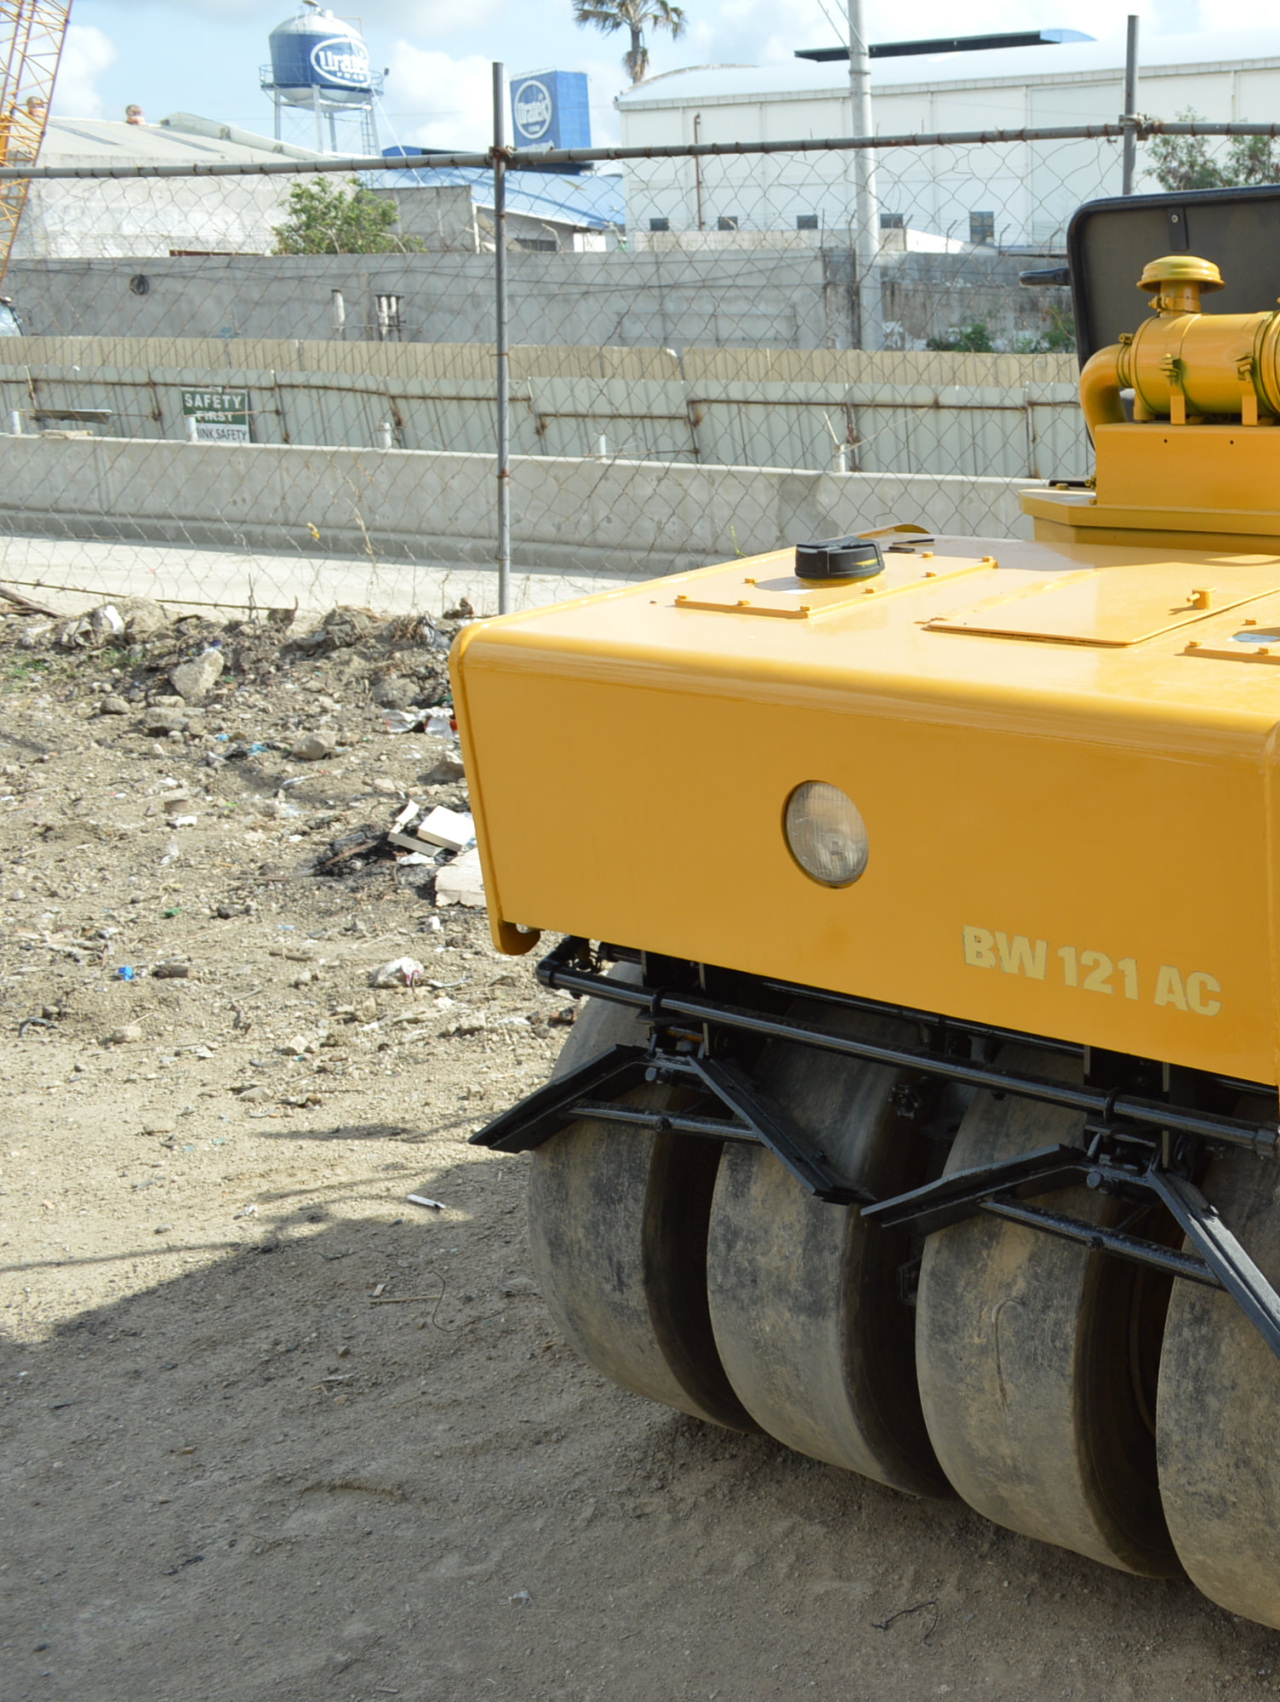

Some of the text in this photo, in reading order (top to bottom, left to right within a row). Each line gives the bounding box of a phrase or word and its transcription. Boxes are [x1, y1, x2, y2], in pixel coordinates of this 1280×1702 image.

[184, 393, 242, 409] SAFETY
[195, 410, 233, 422] FIRST
[215, 428, 247, 441] SAFETY
[963, 924, 1223, 1017] BW 121 AC
